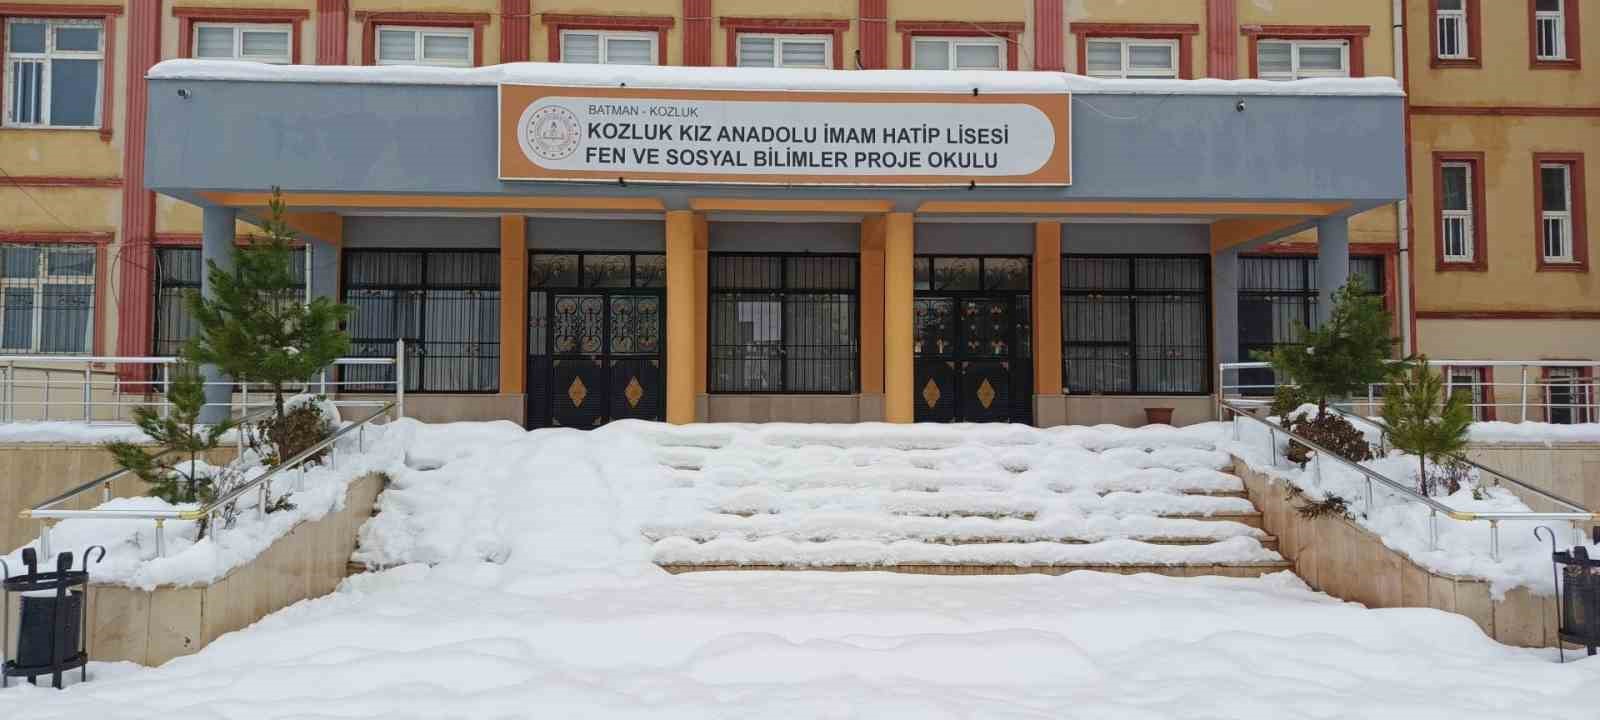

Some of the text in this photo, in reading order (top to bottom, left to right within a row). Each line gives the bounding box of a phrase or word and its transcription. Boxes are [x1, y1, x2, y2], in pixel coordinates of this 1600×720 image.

[588, 104, 639, 116] BATMAN
[649, 106, 698, 118] KOZLUK
[587, 122, 673, 141] KOZLUK
[679, 124, 712, 142] KIZ
[716, 125, 817, 144] ANADOLU
[824, 123, 876, 144] İMAM
[882, 123, 940, 145] HATİP
[946, 124, 1009, 145] LİSESİ
[585, 146, 998, 169] FEN VE SOSYAL BİLİMLER PROJE OKULU
